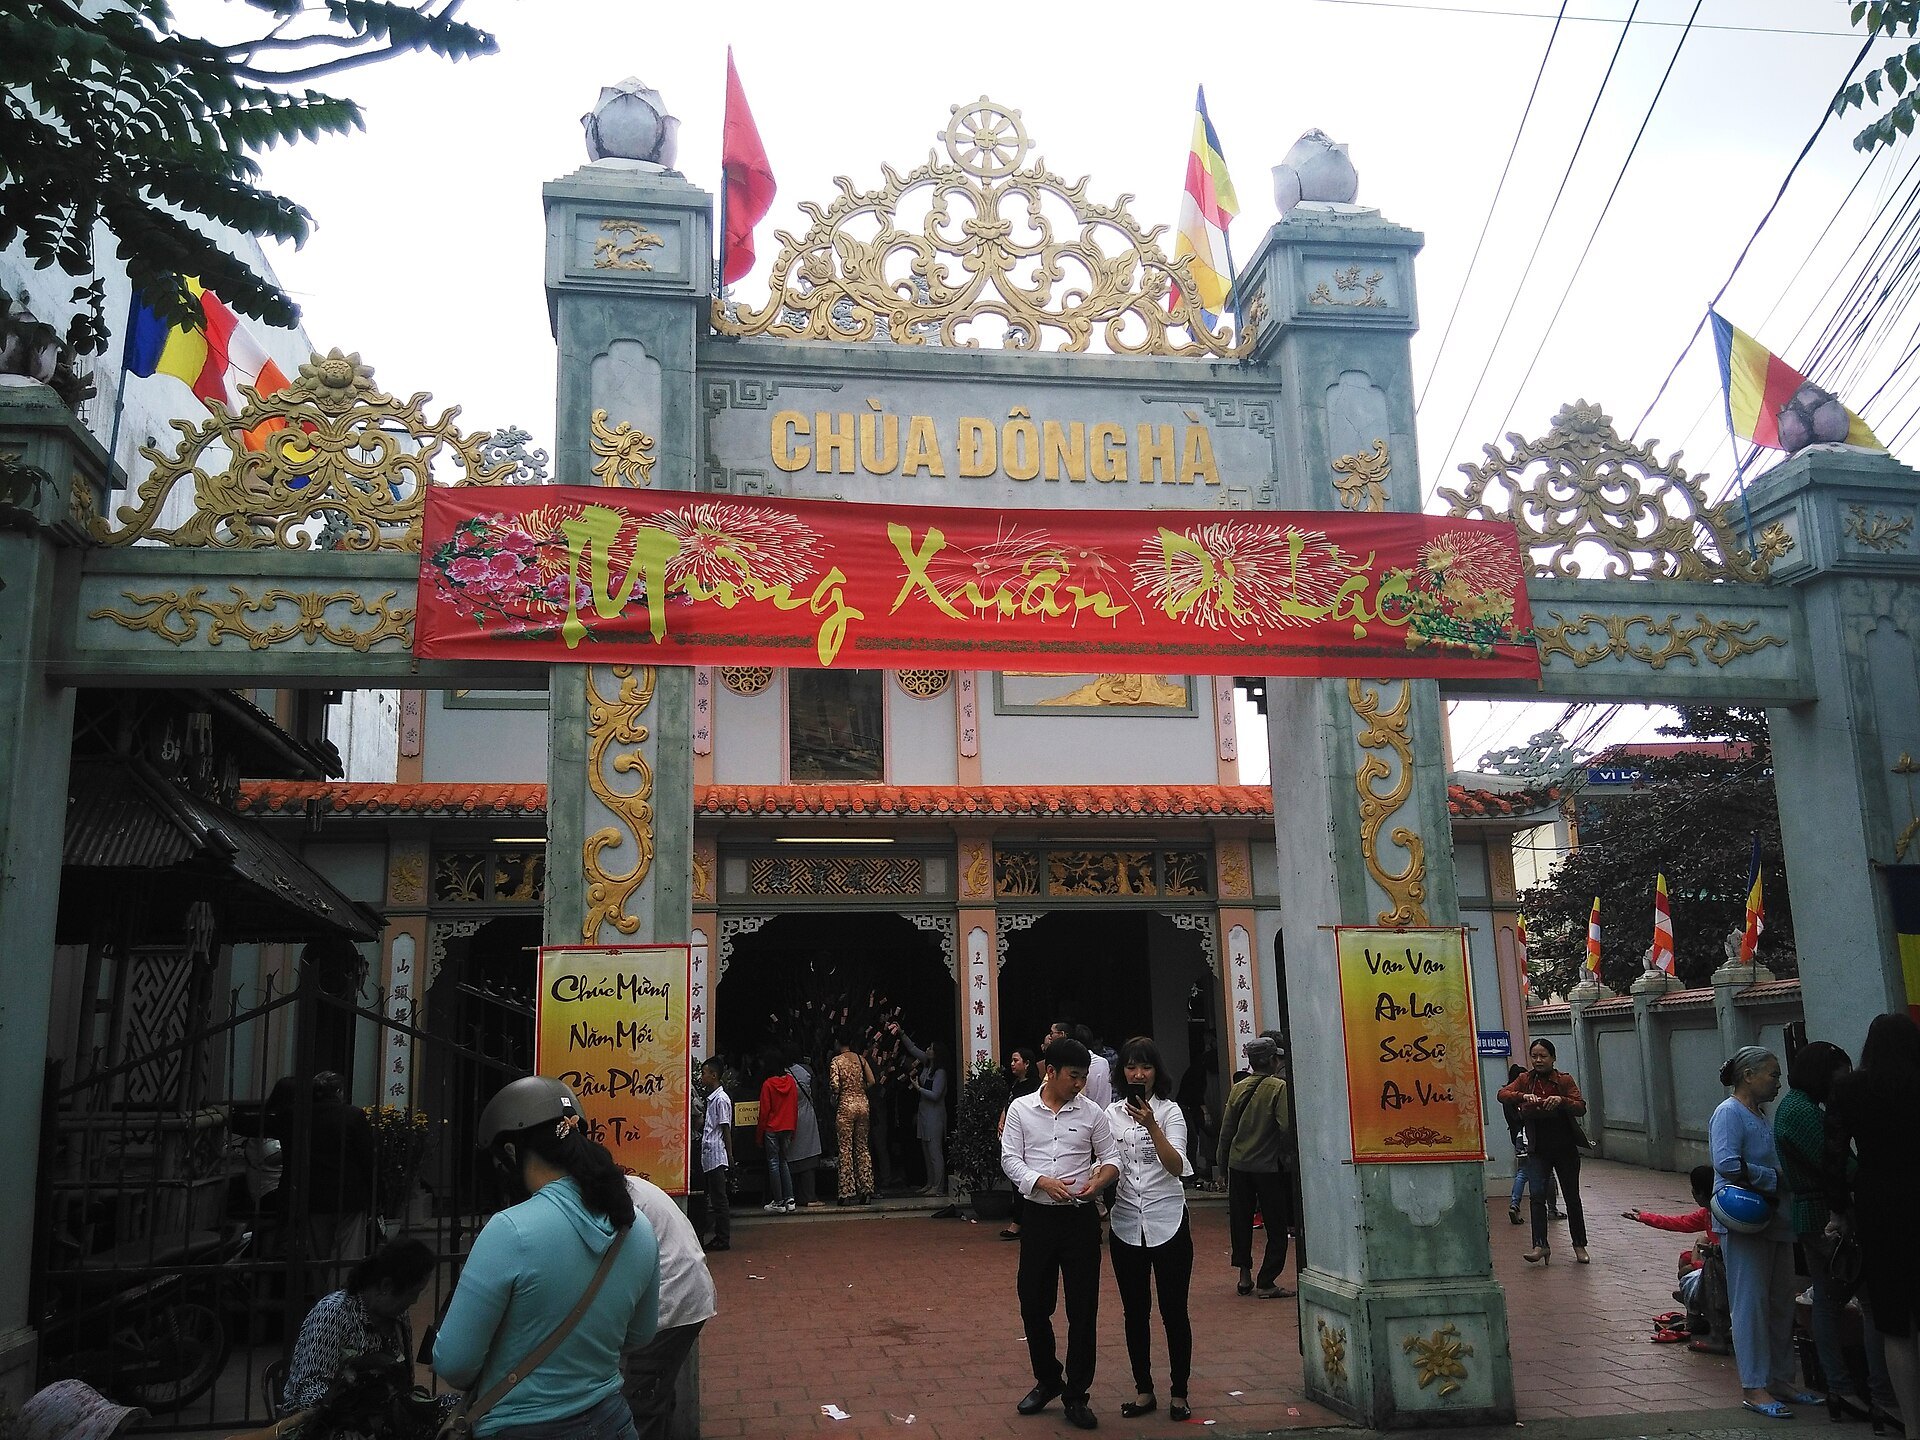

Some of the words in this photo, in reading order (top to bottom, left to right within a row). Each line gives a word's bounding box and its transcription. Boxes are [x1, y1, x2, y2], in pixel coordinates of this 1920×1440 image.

[770, 398, 946, 478] CHÙA
[957, 405, 1128, 483] ĐÔNG
[1137, 410, 1221, 485] HÀ
[560, 505, 865, 667] Mừng
[886, 521, 1132, 621] Xuân
[1364, 948, 1405, 976] Vạn
[1406, 948, 1446, 976] Vạn
[551, 974, 615, 1002] Chúc
[616, 972, 671, 1021] Mừng
[1375, 992, 1409, 1022] An
[569, 1020, 614, 1053] Năm
[615, 1020, 654, 1051] Mới
[607, 1068, 665, 1099] Phật
[1381, 1080, 1414, 1110] An
[1415, 1079, 1454, 1107] Vui
